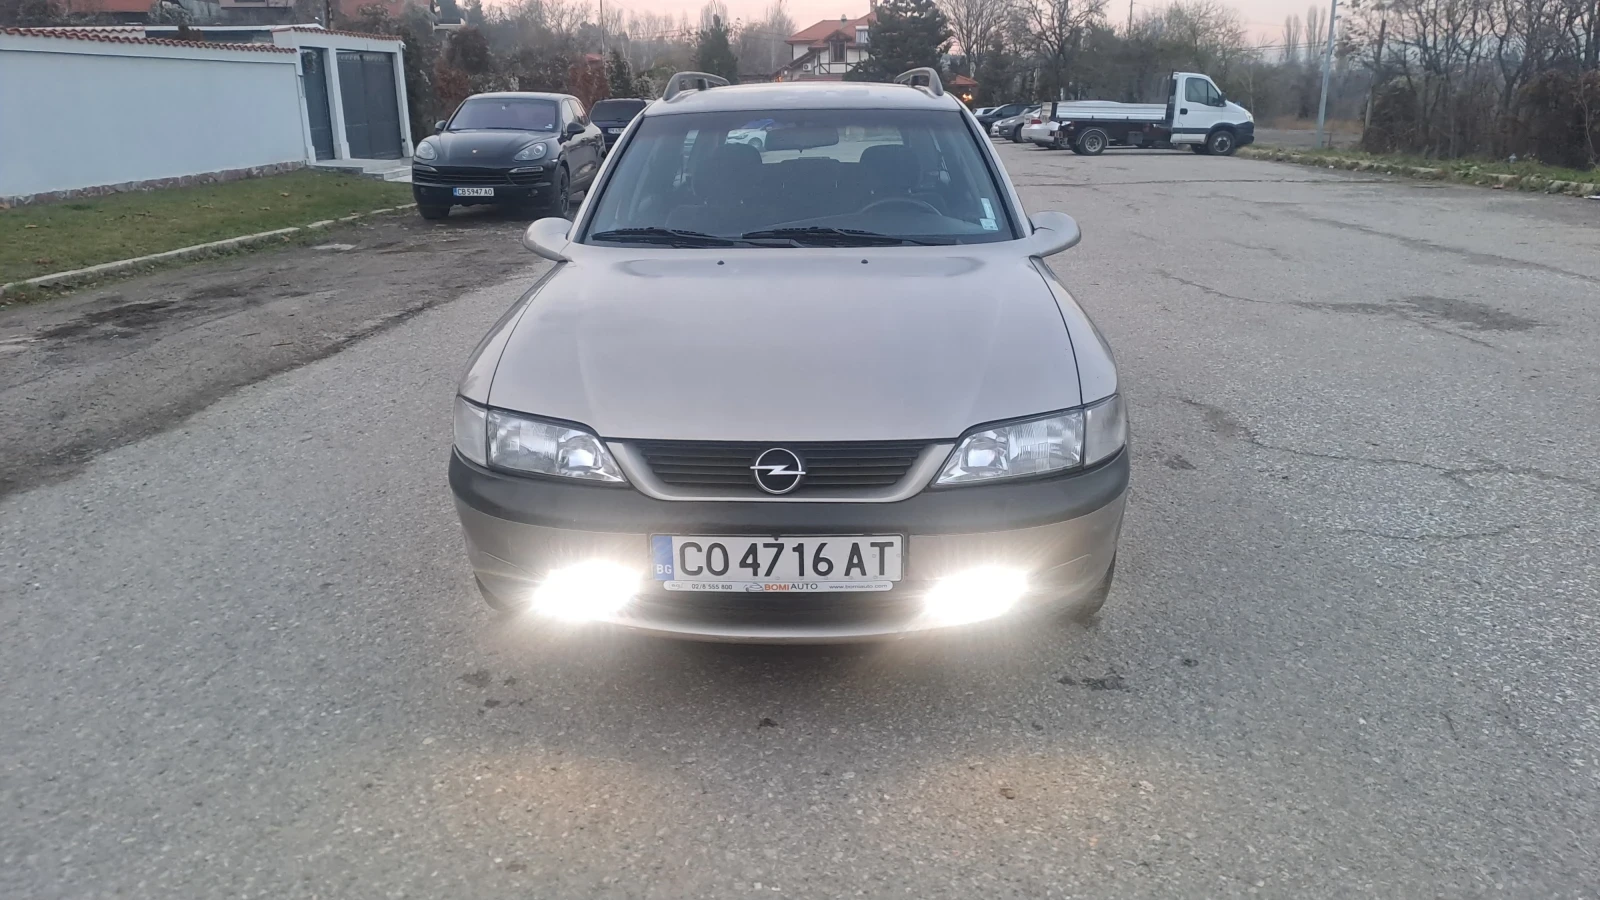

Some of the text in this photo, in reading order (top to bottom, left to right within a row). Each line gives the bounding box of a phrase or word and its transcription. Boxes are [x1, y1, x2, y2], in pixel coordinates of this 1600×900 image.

[656, 563, 672, 575] BG
[679, 541, 894, 577] CO 4716 AT
